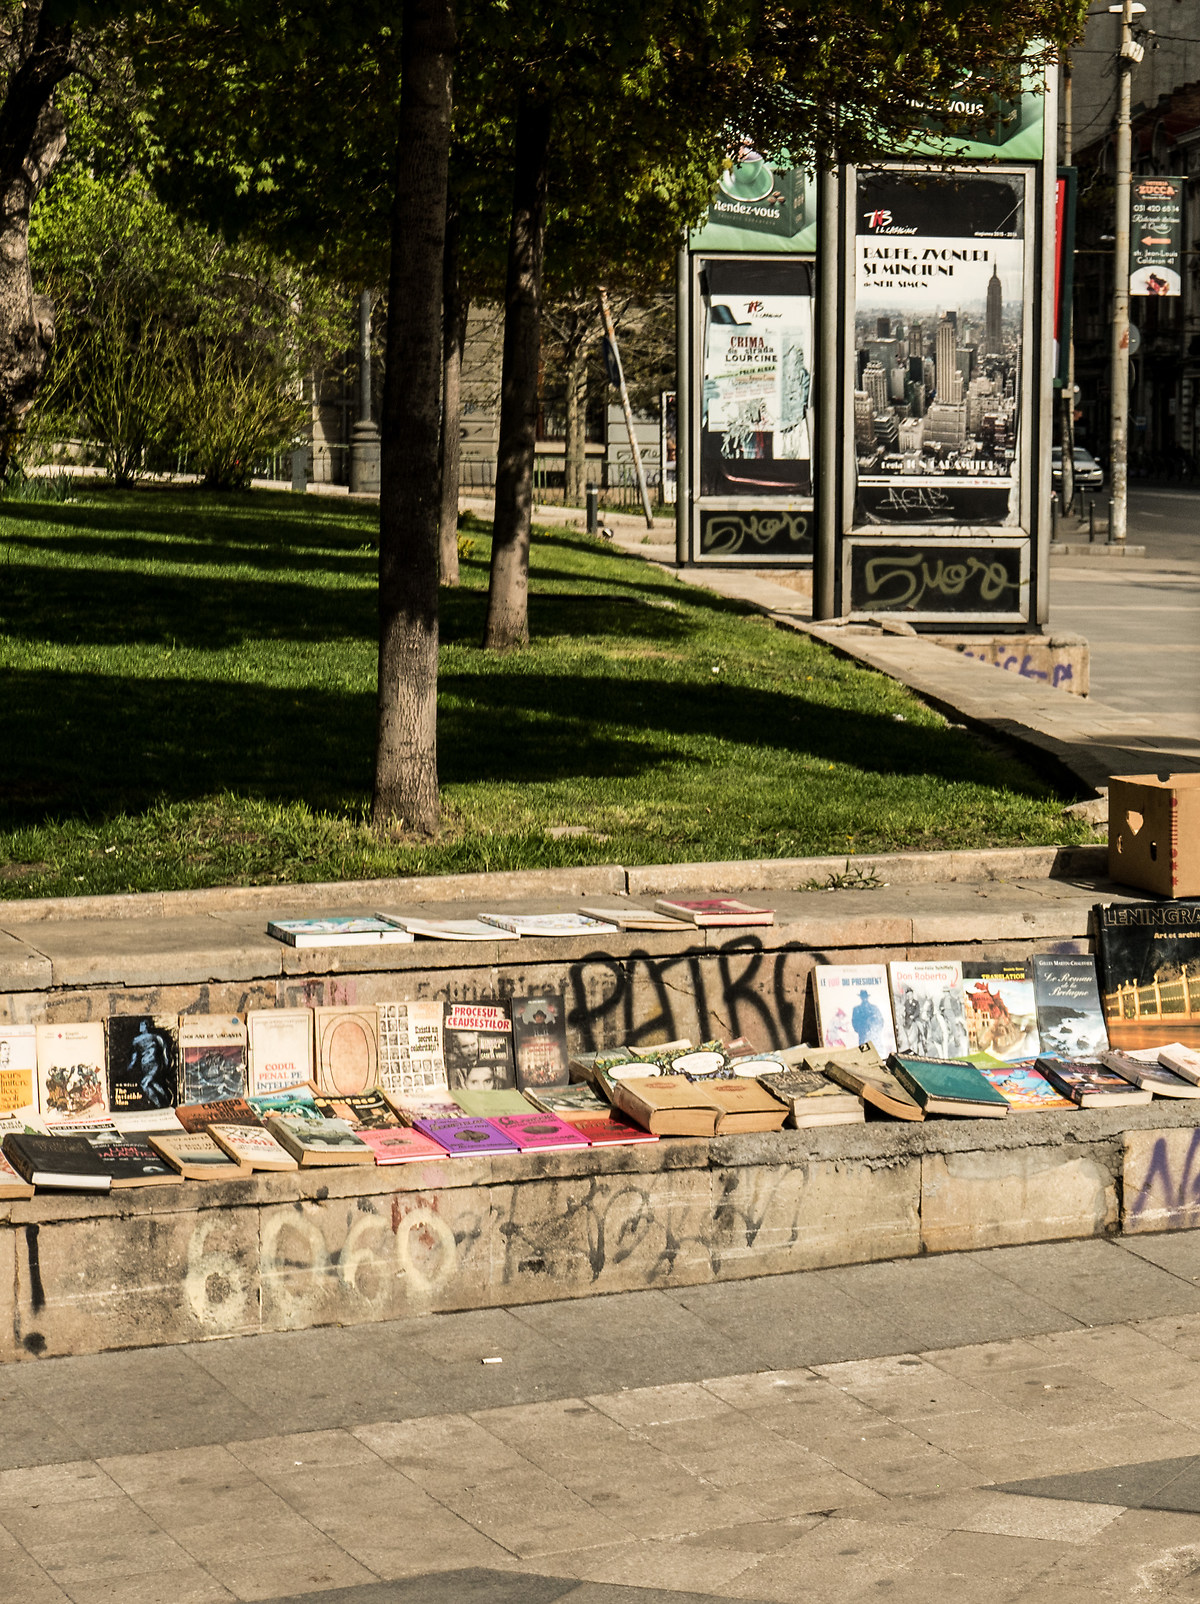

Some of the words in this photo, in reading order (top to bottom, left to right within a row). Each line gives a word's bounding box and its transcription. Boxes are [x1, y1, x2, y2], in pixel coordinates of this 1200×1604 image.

[1138, 186, 1175, 195] ZUCCA
[881, 264, 954, 276] MINCIUNI
[730, 336, 765, 348] CRIMA
[725, 354, 778, 363] LOURCINE
[896, 971, 913, 981] Don
[915, 971, 948, 981] Roberto
[454, 1007, 498, 1018] PROCESUL
[264, 1063, 297, 1071] CODUL
[259, 1072, 290, 1080] PENAL
[291, 1071, 303, 1079] PE
